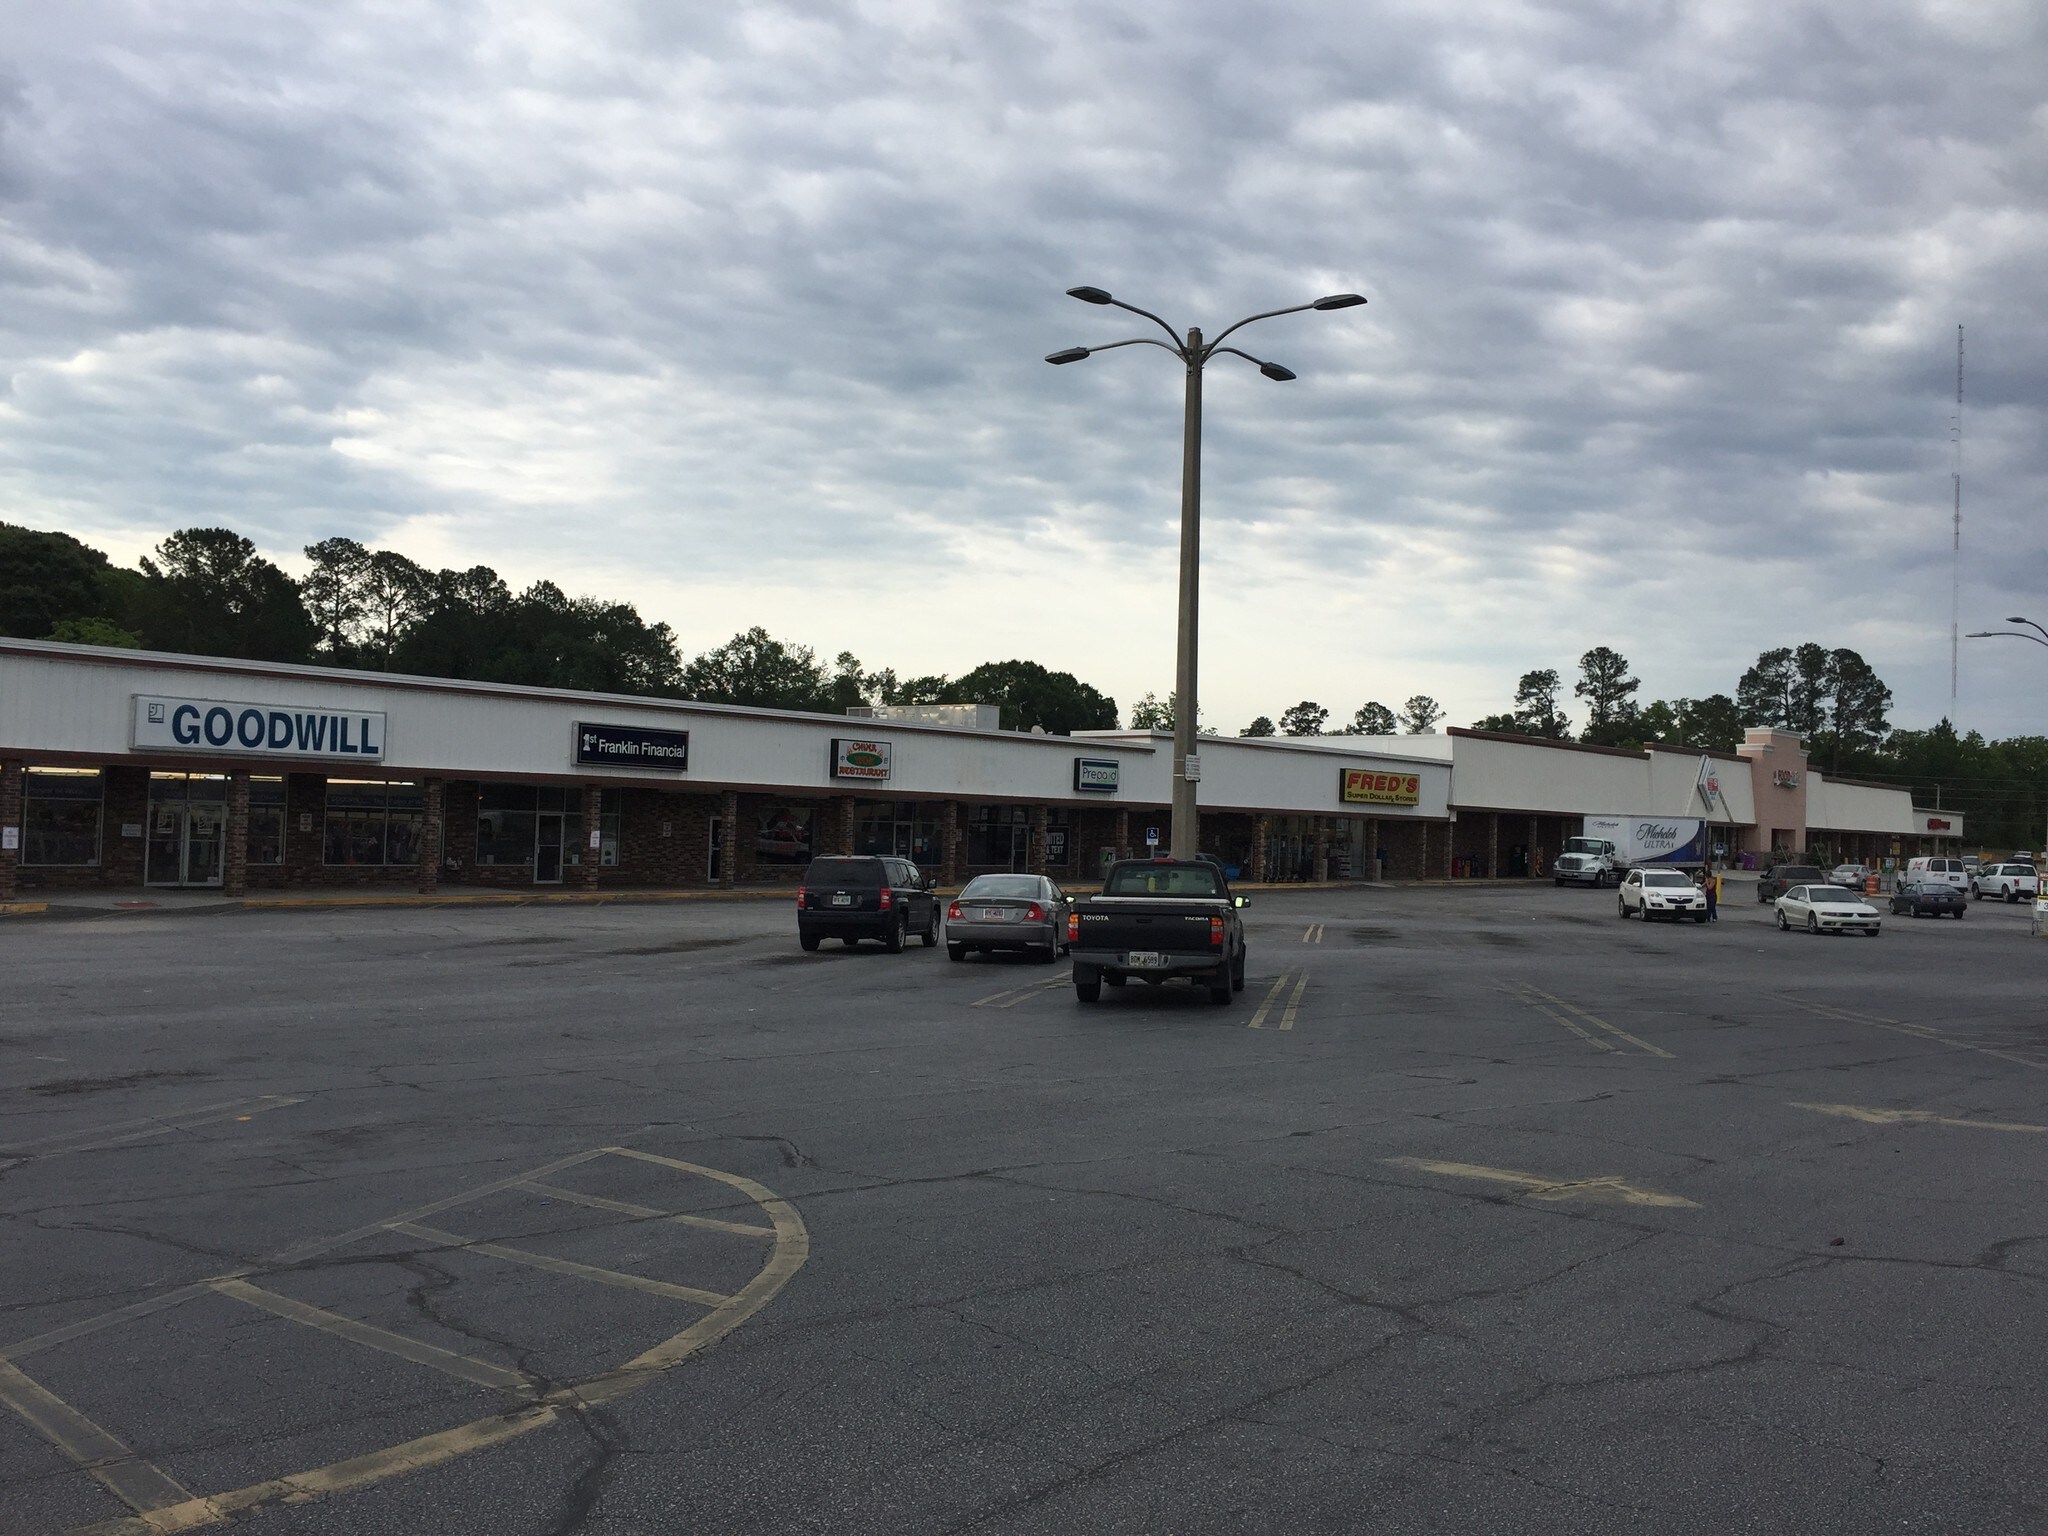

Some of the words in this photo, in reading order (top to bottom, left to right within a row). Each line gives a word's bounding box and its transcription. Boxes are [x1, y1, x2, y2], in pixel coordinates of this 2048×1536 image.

[172, 704, 379, 754] GOODWILL
[583, 733, 597, 751] 1st
[598, 739, 639, 755] Franklin
[641, 742, 685, 758] Financial
[839, 766, 888, 777] RESTAURANT
[1082, 767, 1117, 781] Prepad
[1347, 773, 1418, 793] FRED'S
[1636, 823, 1678, 840] Michelob
[1051, 846, 1064, 854] TEXT
[1644, 840, 1670, 849] ULTRA
